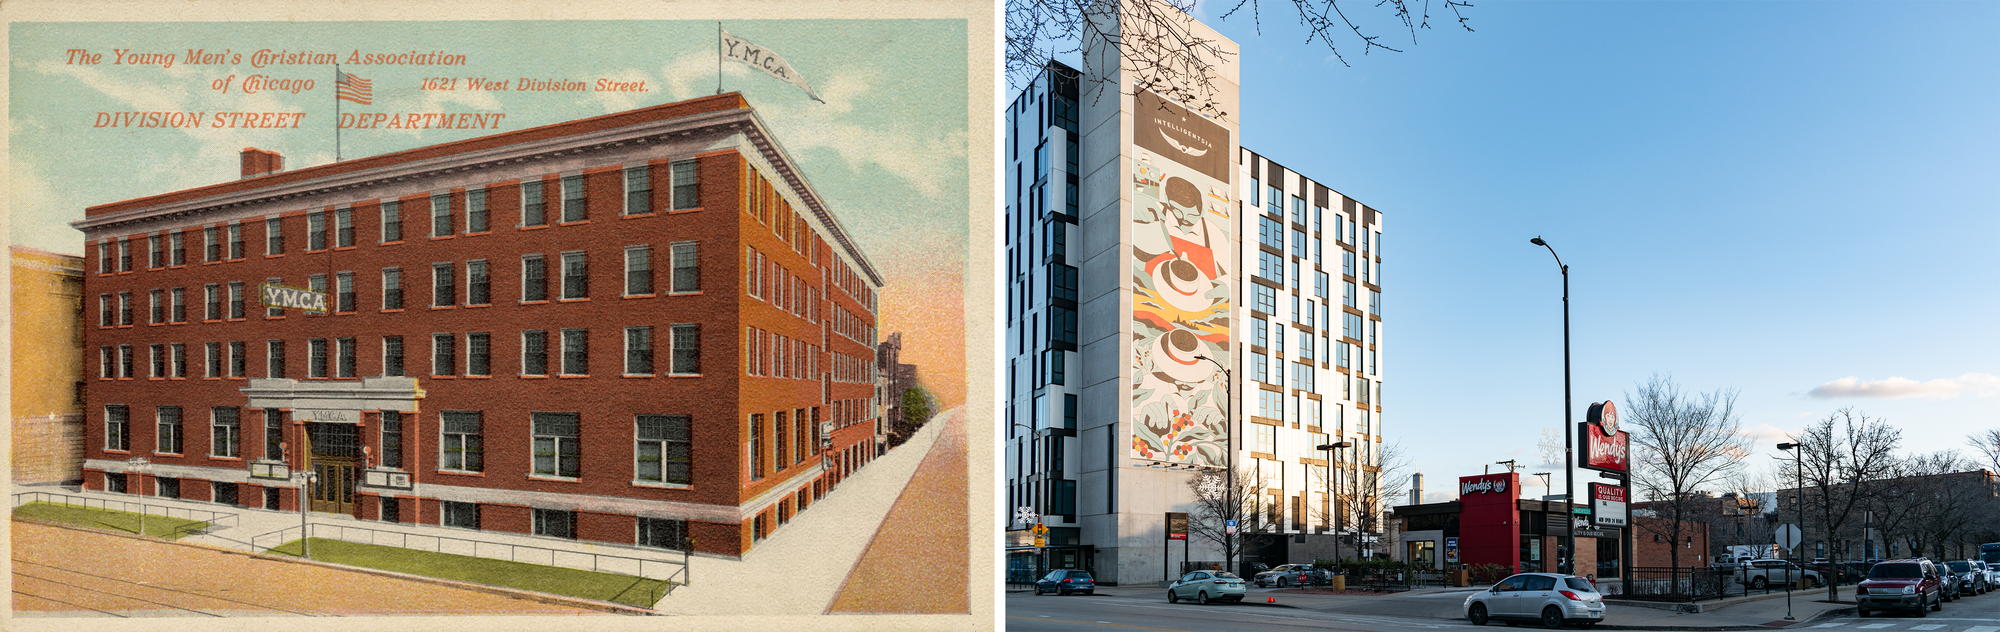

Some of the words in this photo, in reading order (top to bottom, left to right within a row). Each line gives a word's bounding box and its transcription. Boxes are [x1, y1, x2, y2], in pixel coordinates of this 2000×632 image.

[66, 49, 102, 66] The
[113, 49, 176, 69] Young
[183, 49, 242, 66] Men's
[251, 49, 337, 68] Christian
[345, 49, 467, 66] Association
[725, 39, 789, 80] Y.M.C.A.
[212, 74, 235, 94] of
[242, 74, 315, 94] Chicago
[420, 77, 457, 91] 1621
[467, 77, 509, 92] West
[516, 77, 587, 92] Division
[594, 78, 649, 92] Street.
[93, 112, 206, 129] DIVISION
[212, 112, 306, 129] STREET
[338, 113, 506, 130] DEPARTMENT
[1154, 118, 1212, 148] INTELLIGENTSIA
[1590, 435, 1626, 464] Wendy's
[1461, 478, 1492, 496] Wendy's
[1598, 486, 1624, 496] QUALITY
[1574, 515, 1592, 530] Wendy
